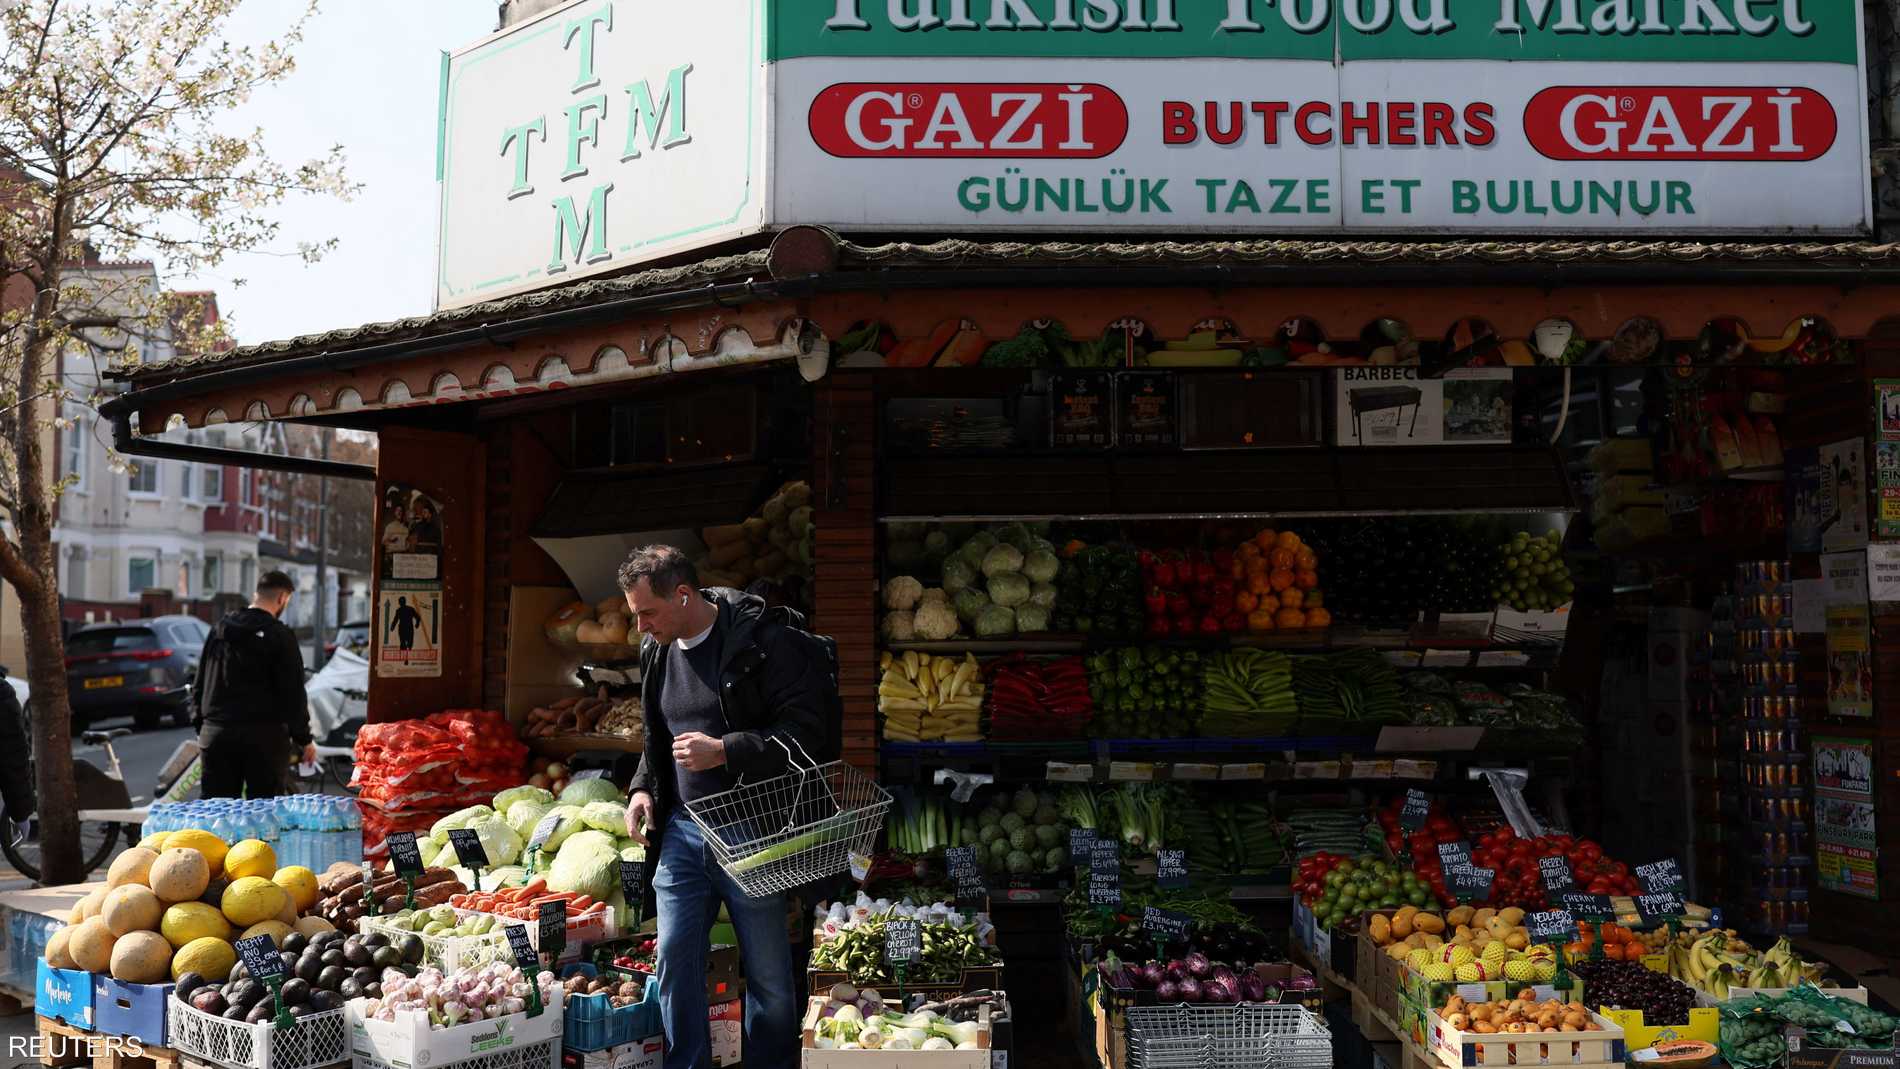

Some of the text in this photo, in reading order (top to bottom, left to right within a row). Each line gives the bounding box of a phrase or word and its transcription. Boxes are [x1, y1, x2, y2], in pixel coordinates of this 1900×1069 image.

[1162, 101, 1495, 147] BUTCHERS
[957, 167, 1696, 215] GÜNLÜK TAZE ET BULUNUR
[1639, 891, 1675, 906] BANANA
[886, 920, 908, 931] BLACK
[890, 930, 917, 940] YELLOW
[243, 947, 260, 959] AVO
[470, 1035, 514, 1052] LEEKS
[471, 1031, 499, 1045] Seddons
[1848, 1055, 1894, 1066] PREMIUM
